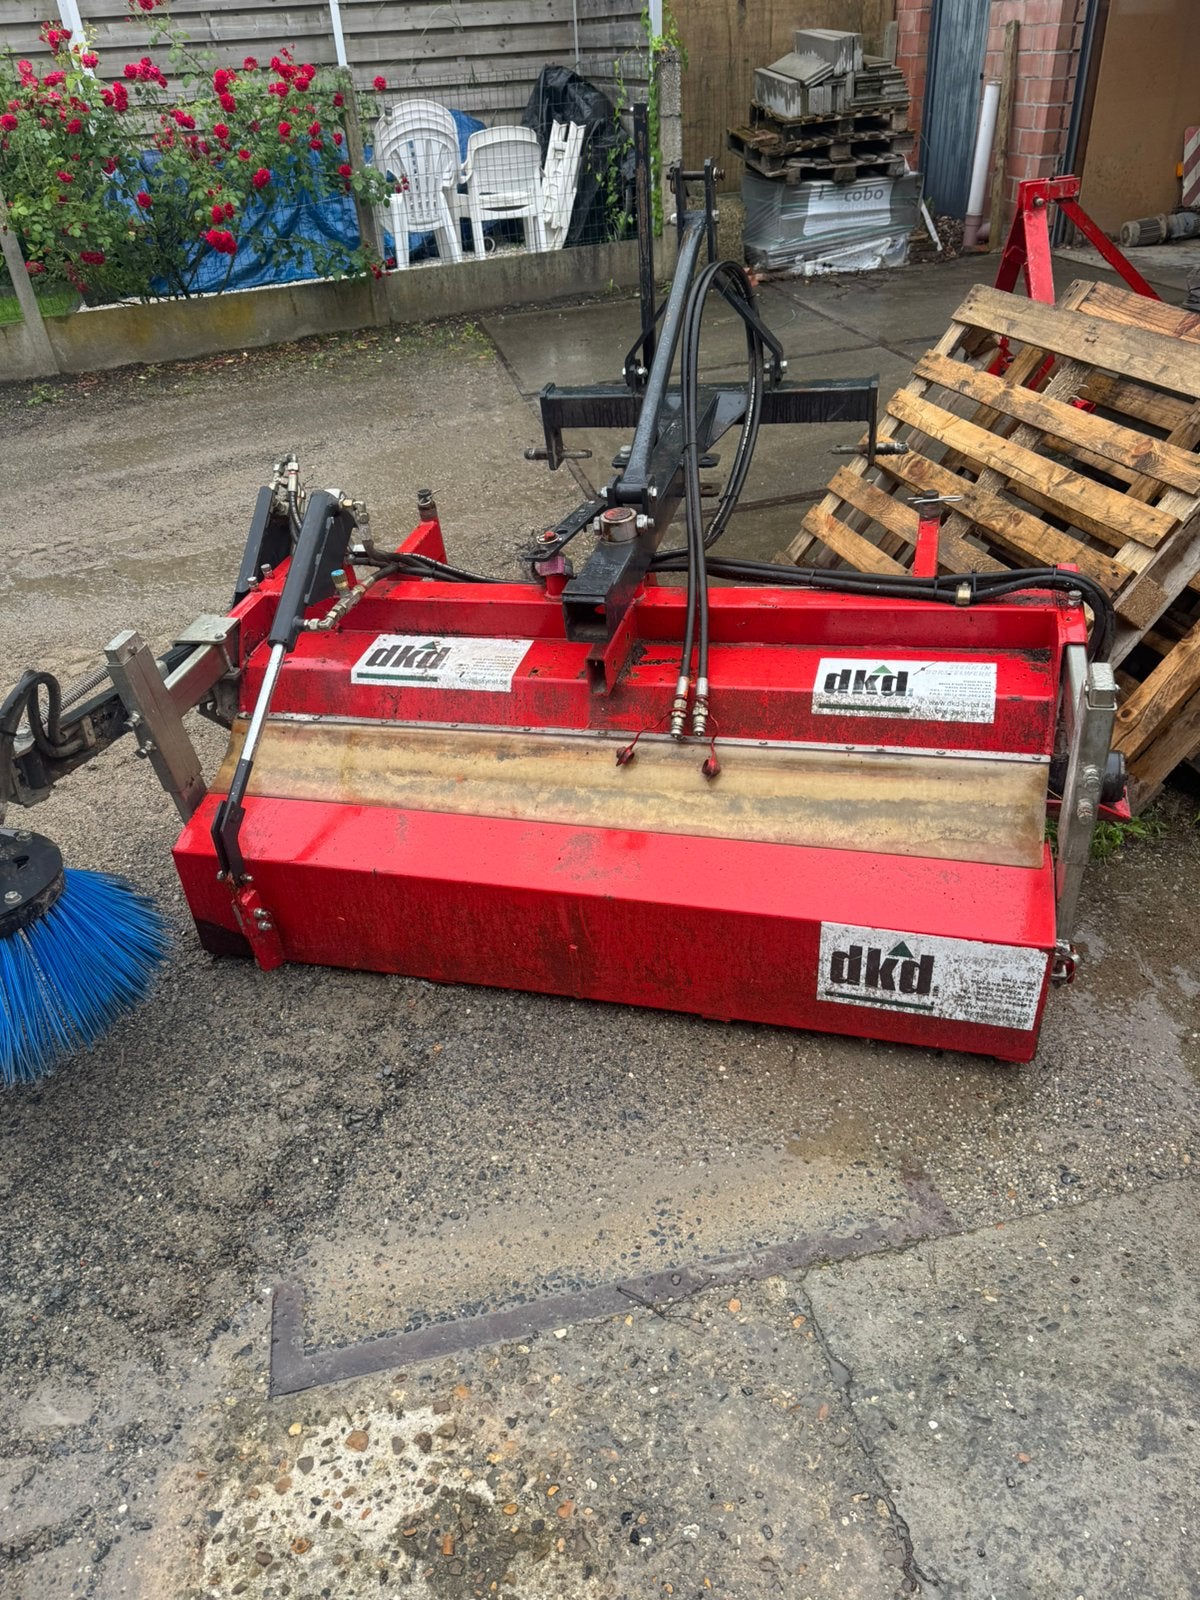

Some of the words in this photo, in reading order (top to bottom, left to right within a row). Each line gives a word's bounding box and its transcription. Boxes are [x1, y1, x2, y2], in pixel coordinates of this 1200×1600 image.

[844, 186, 884, 202] cobo
[365, 644, 451, 670] dkd
[824, 669, 909, 697] dkd
[830, 945, 935, 996] dkd
